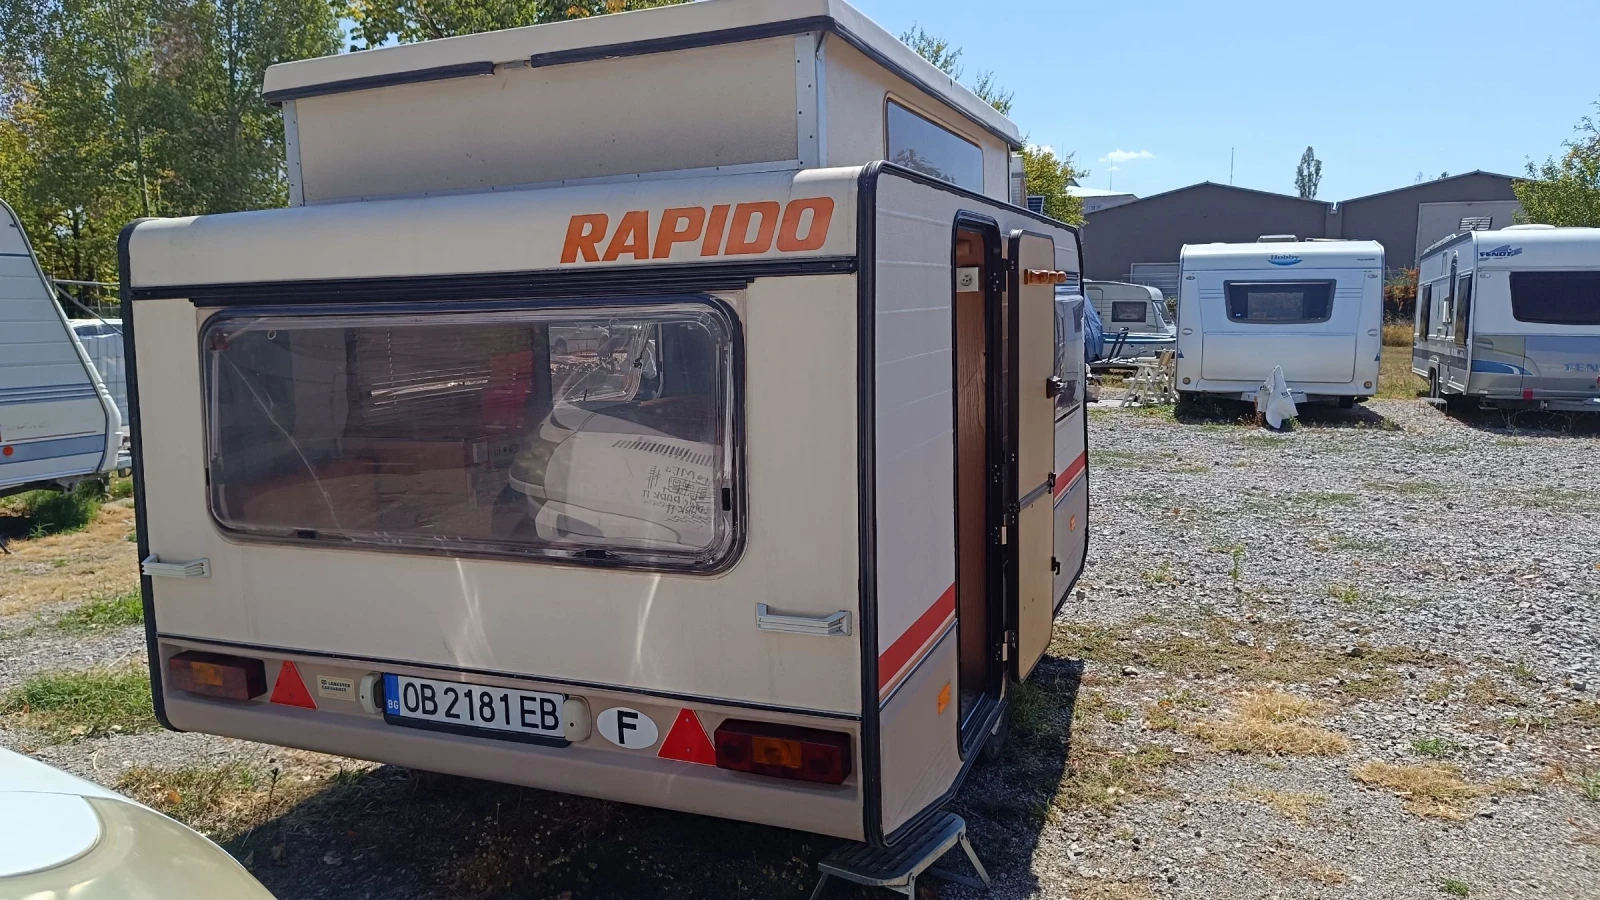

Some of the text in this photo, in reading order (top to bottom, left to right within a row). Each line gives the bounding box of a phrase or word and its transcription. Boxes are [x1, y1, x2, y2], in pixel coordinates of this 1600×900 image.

[560, 196, 835, 264] RAPIDO
[1270, 253, 1301, 262] Hobby
[387, 699, 399, 710] BG
[616, 710, 639, 745] F
